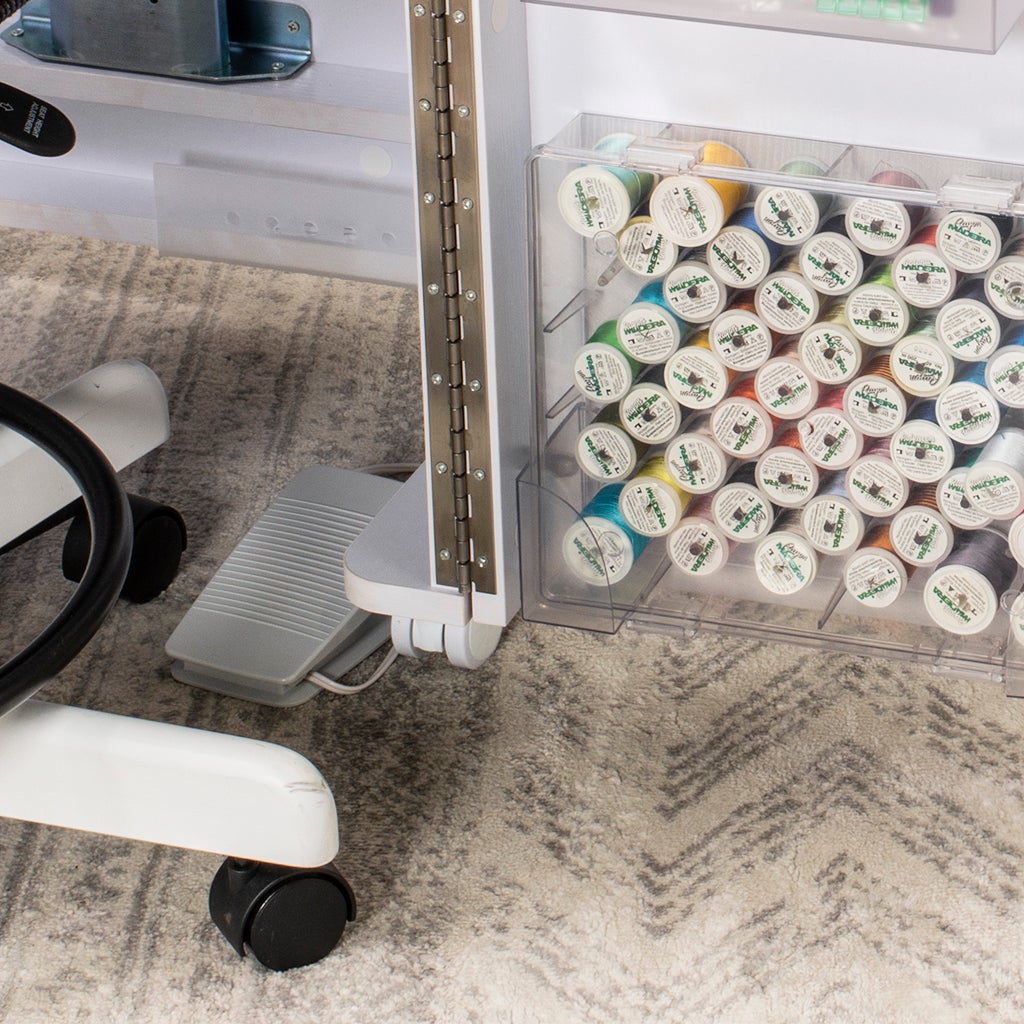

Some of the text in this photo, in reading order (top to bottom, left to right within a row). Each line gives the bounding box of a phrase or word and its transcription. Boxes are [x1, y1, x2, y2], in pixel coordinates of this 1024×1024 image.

[767, 196, 795, 238] MAIRA
[947, 223, 991, 246] MADEIRA
[807, 253, 846, 287] MADIRA
[953, 325, 992, 350] MADEIRA
[823, 333, 848, 375] MAIRA
[586, 355, 603, 397] MADEIRA
[898, 357, 942, 378] MAIRA
[855, 391, 898, 411] MADEIRA
[763, 478, 808, 492] MADIRA
